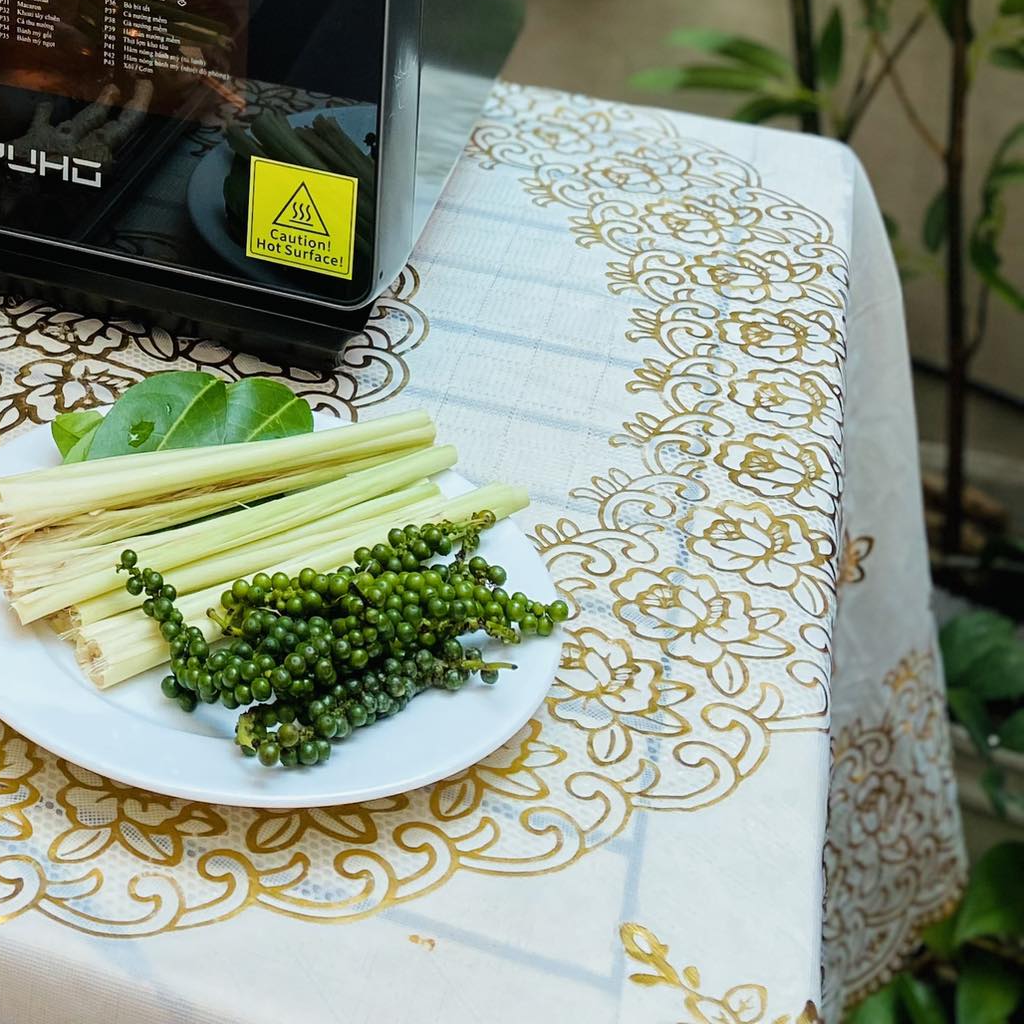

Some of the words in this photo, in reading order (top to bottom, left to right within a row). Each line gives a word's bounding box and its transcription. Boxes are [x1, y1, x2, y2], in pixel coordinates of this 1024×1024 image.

[256, 237, 281, 254] Hot
[284, 244, 343, 267] Surface!
[270, 228, 331, 252] Caution!
